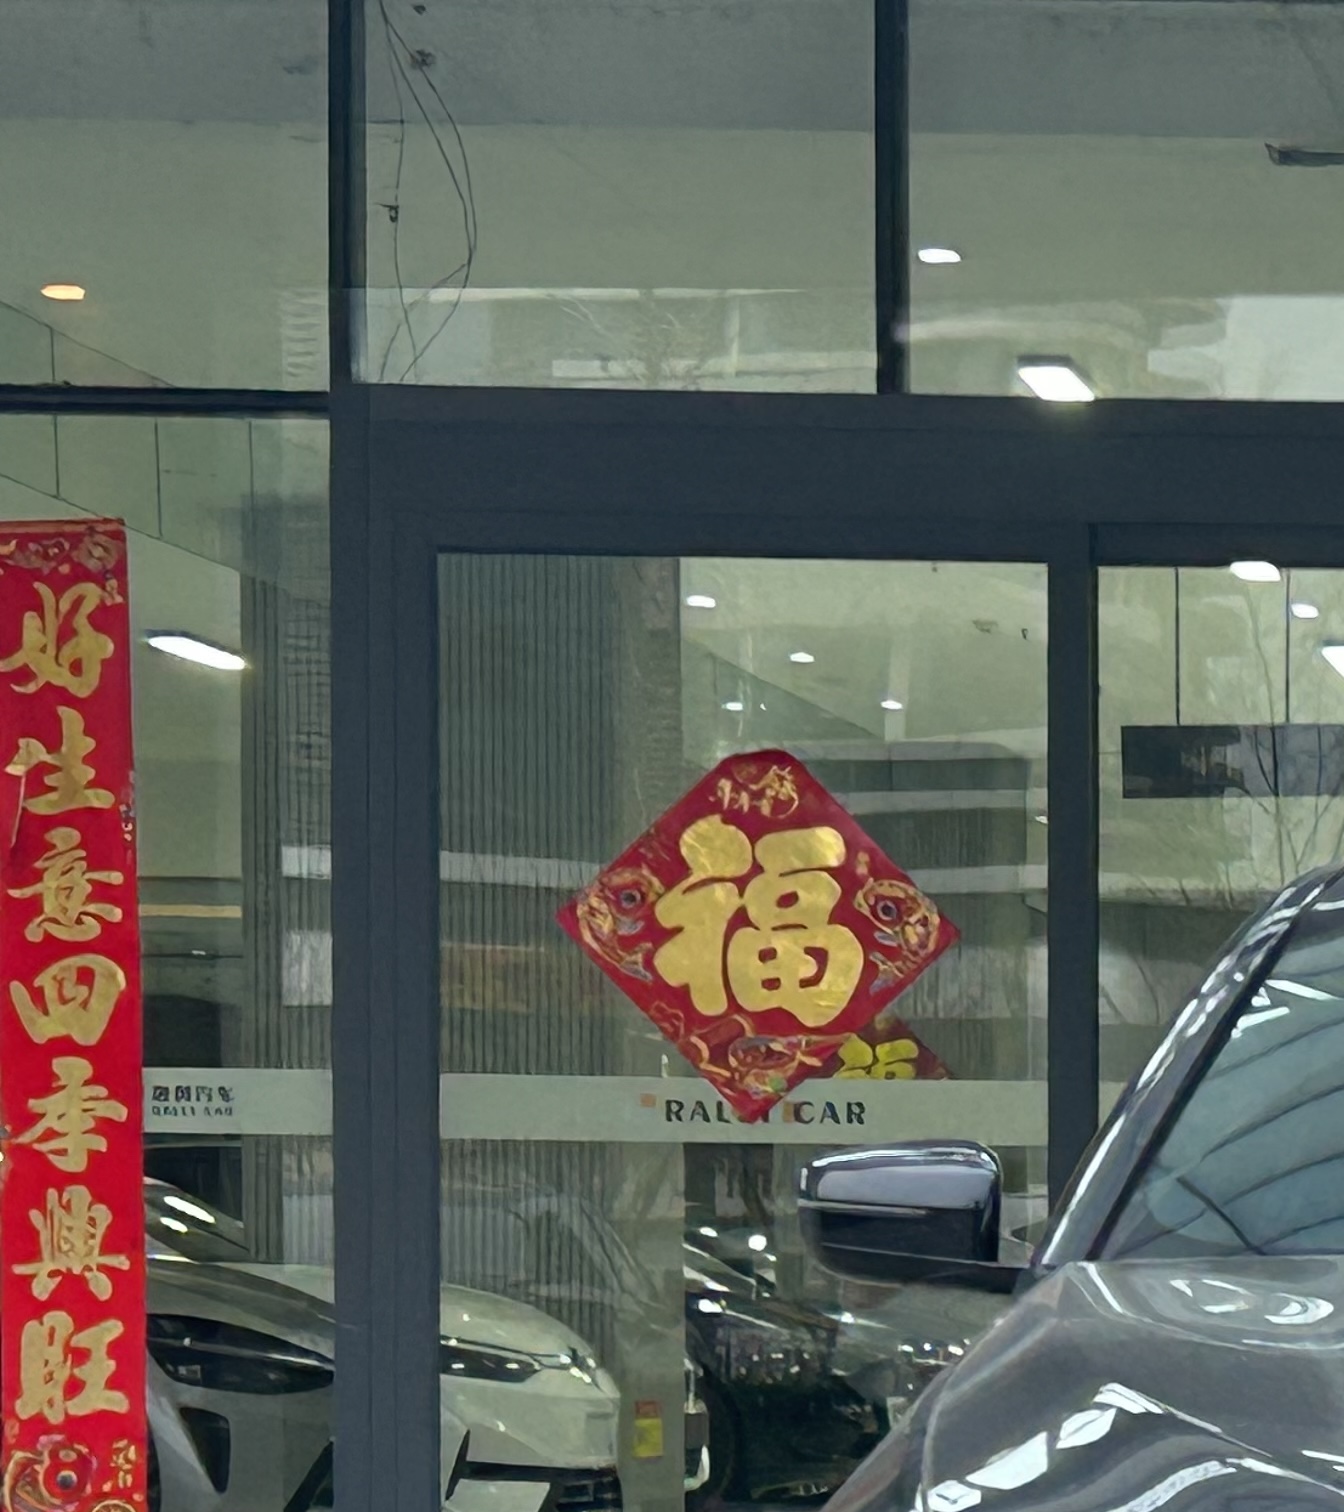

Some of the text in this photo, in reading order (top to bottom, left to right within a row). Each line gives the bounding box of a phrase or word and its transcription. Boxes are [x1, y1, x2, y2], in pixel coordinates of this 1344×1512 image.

[652, 813, 864, 1028] 福
[665, 1099, 866, 1125] RAL CAR
